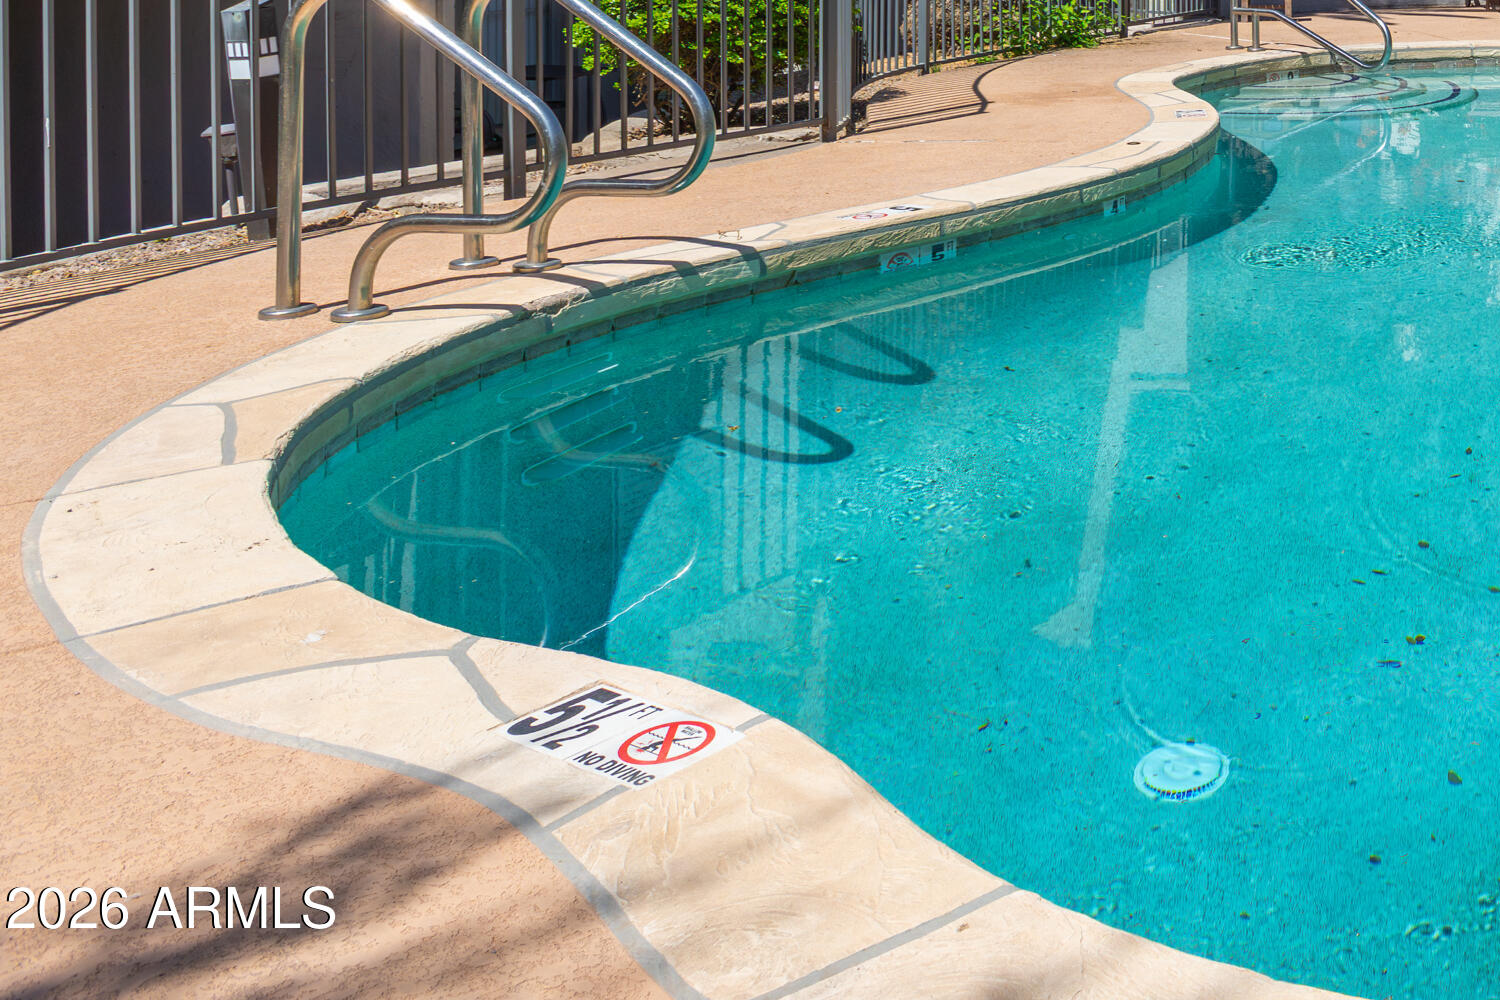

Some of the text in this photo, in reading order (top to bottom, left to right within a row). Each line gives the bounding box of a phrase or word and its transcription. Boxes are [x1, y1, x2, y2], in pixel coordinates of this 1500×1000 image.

[932, 243, 944, 261] 5
[629, 704, 664, 719] FT
[574, 751, 655, 785] NO DIVING
